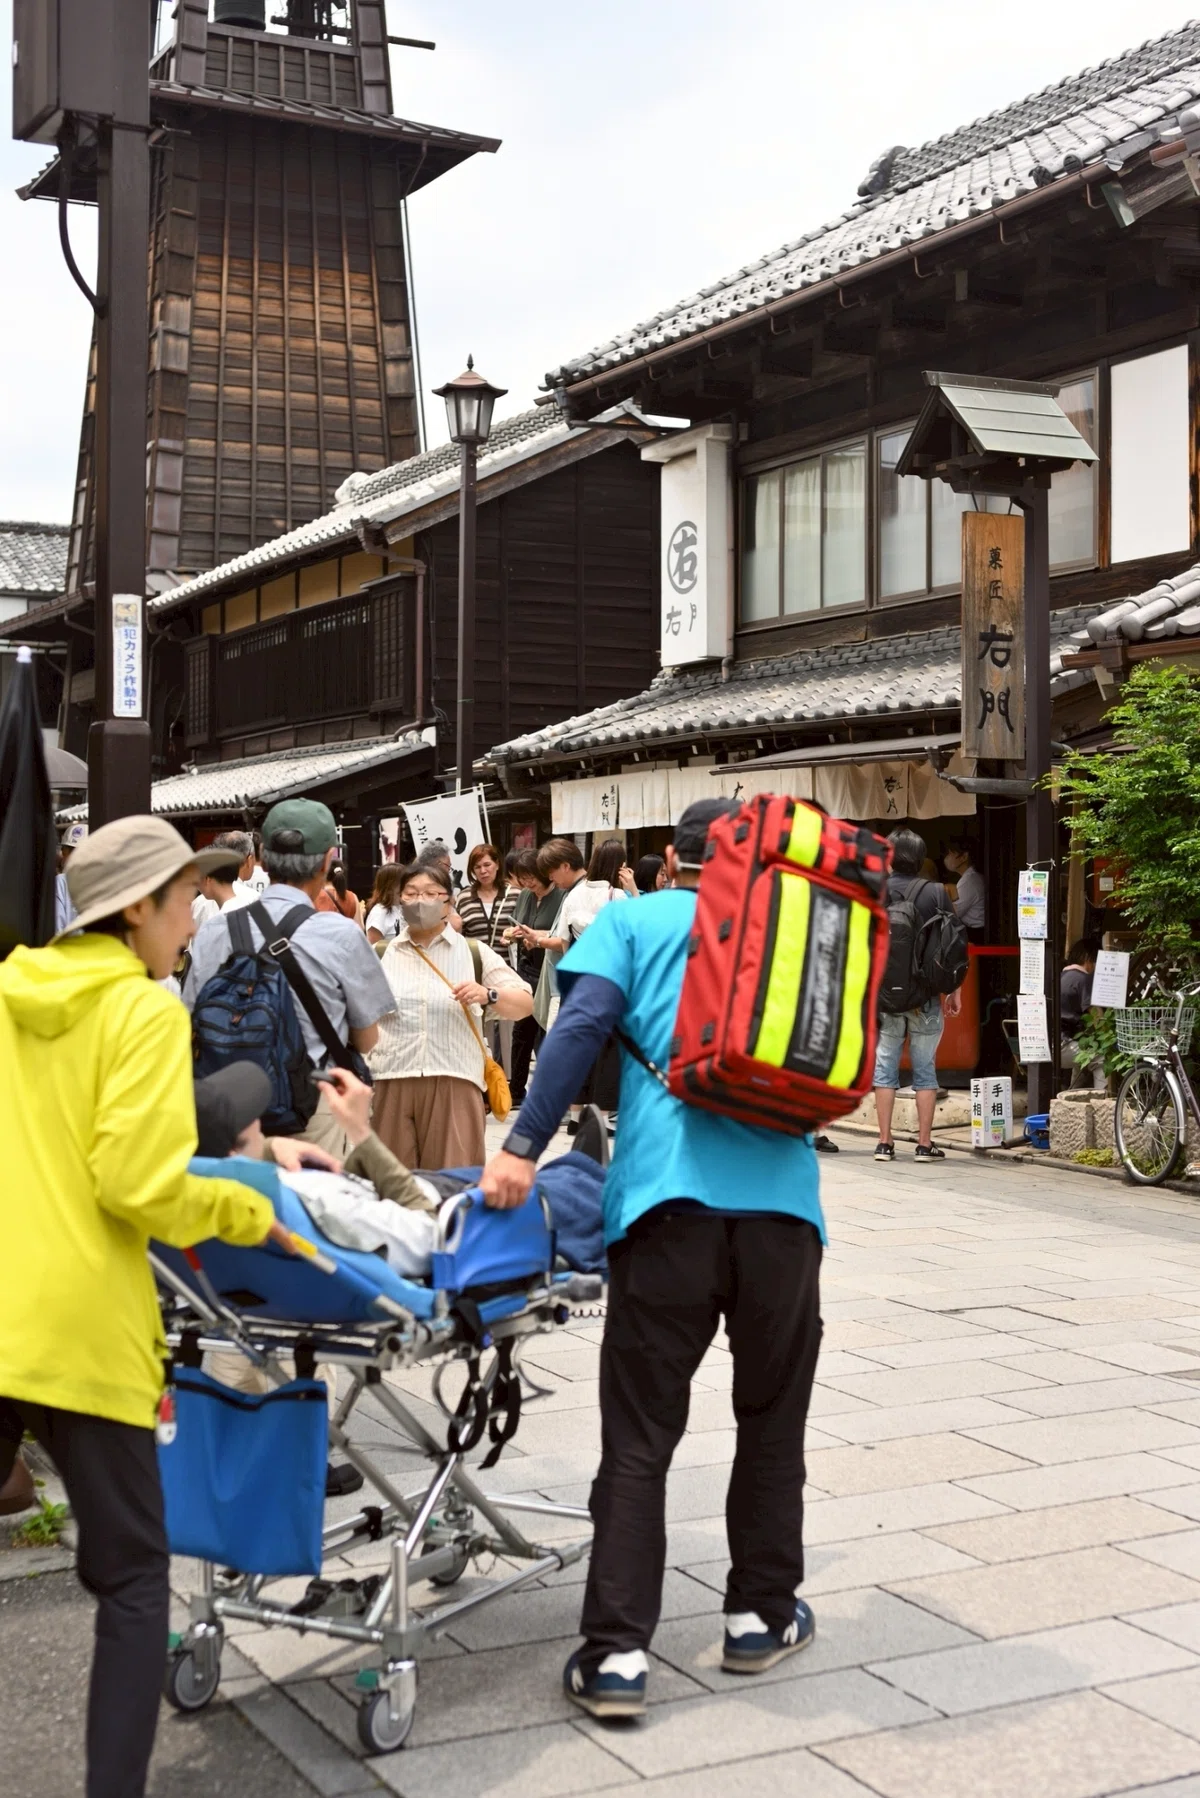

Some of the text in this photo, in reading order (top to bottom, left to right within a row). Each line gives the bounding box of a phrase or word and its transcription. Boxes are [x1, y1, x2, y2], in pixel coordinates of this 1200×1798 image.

[978, 624, 1014, 733] 右門
[972, 1084, 981, 1116] 手相
[991, 1083, 1003, 1116] 手相
